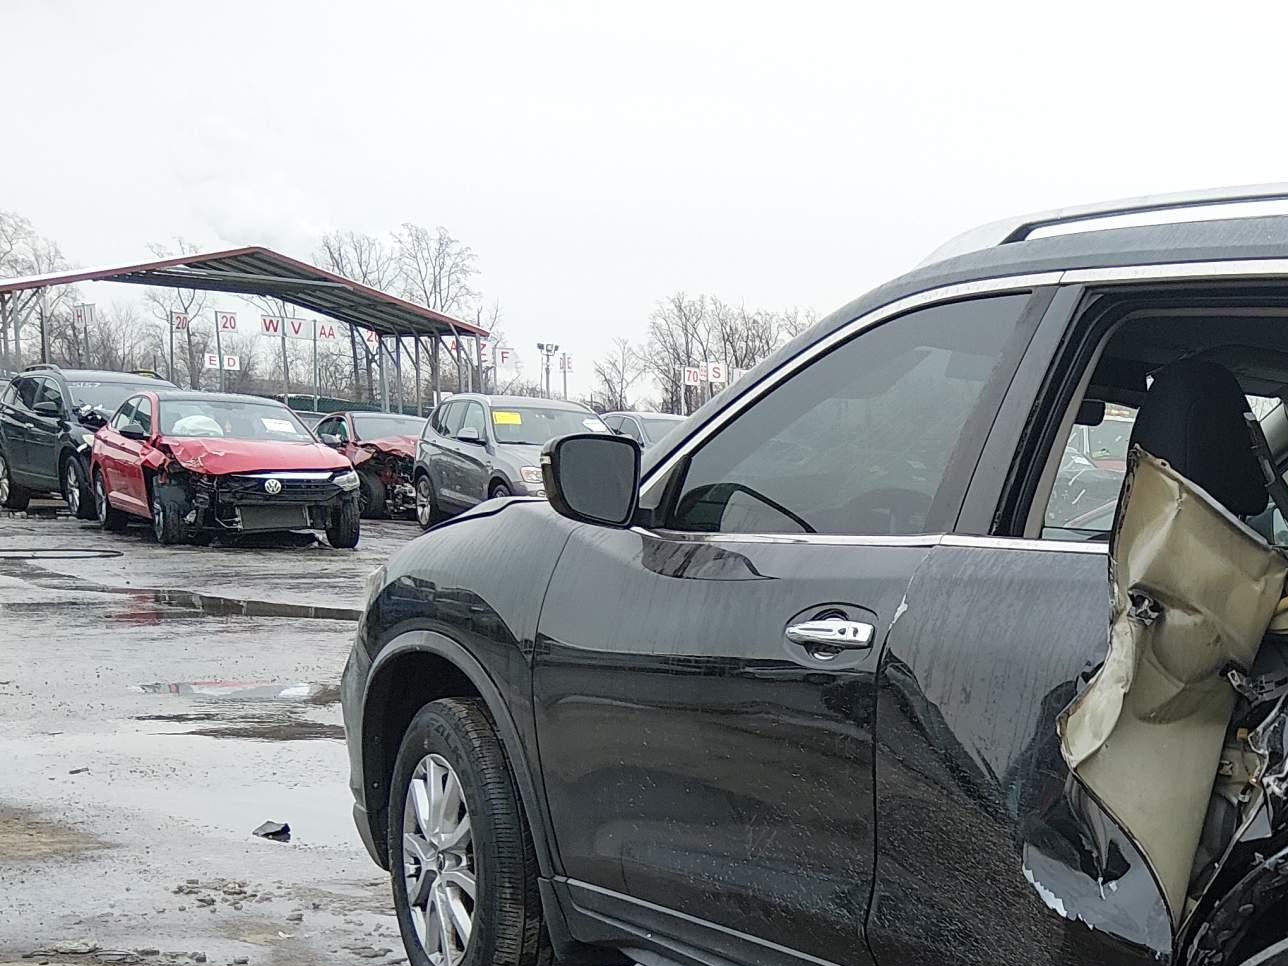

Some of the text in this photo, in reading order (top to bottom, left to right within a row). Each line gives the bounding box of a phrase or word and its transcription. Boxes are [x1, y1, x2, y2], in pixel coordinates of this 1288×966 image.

[175, 316, 187, 329] 20
[221, 315, 236, 329] 20
[263, 318, 302, 335] W V
[319, 325, 336, 339] AA
[208, 355, 236, 367] E D
[501, 351, 510, 364] F
[686, 369, 698, 382] 70
[712, 366, 721, 379] S
